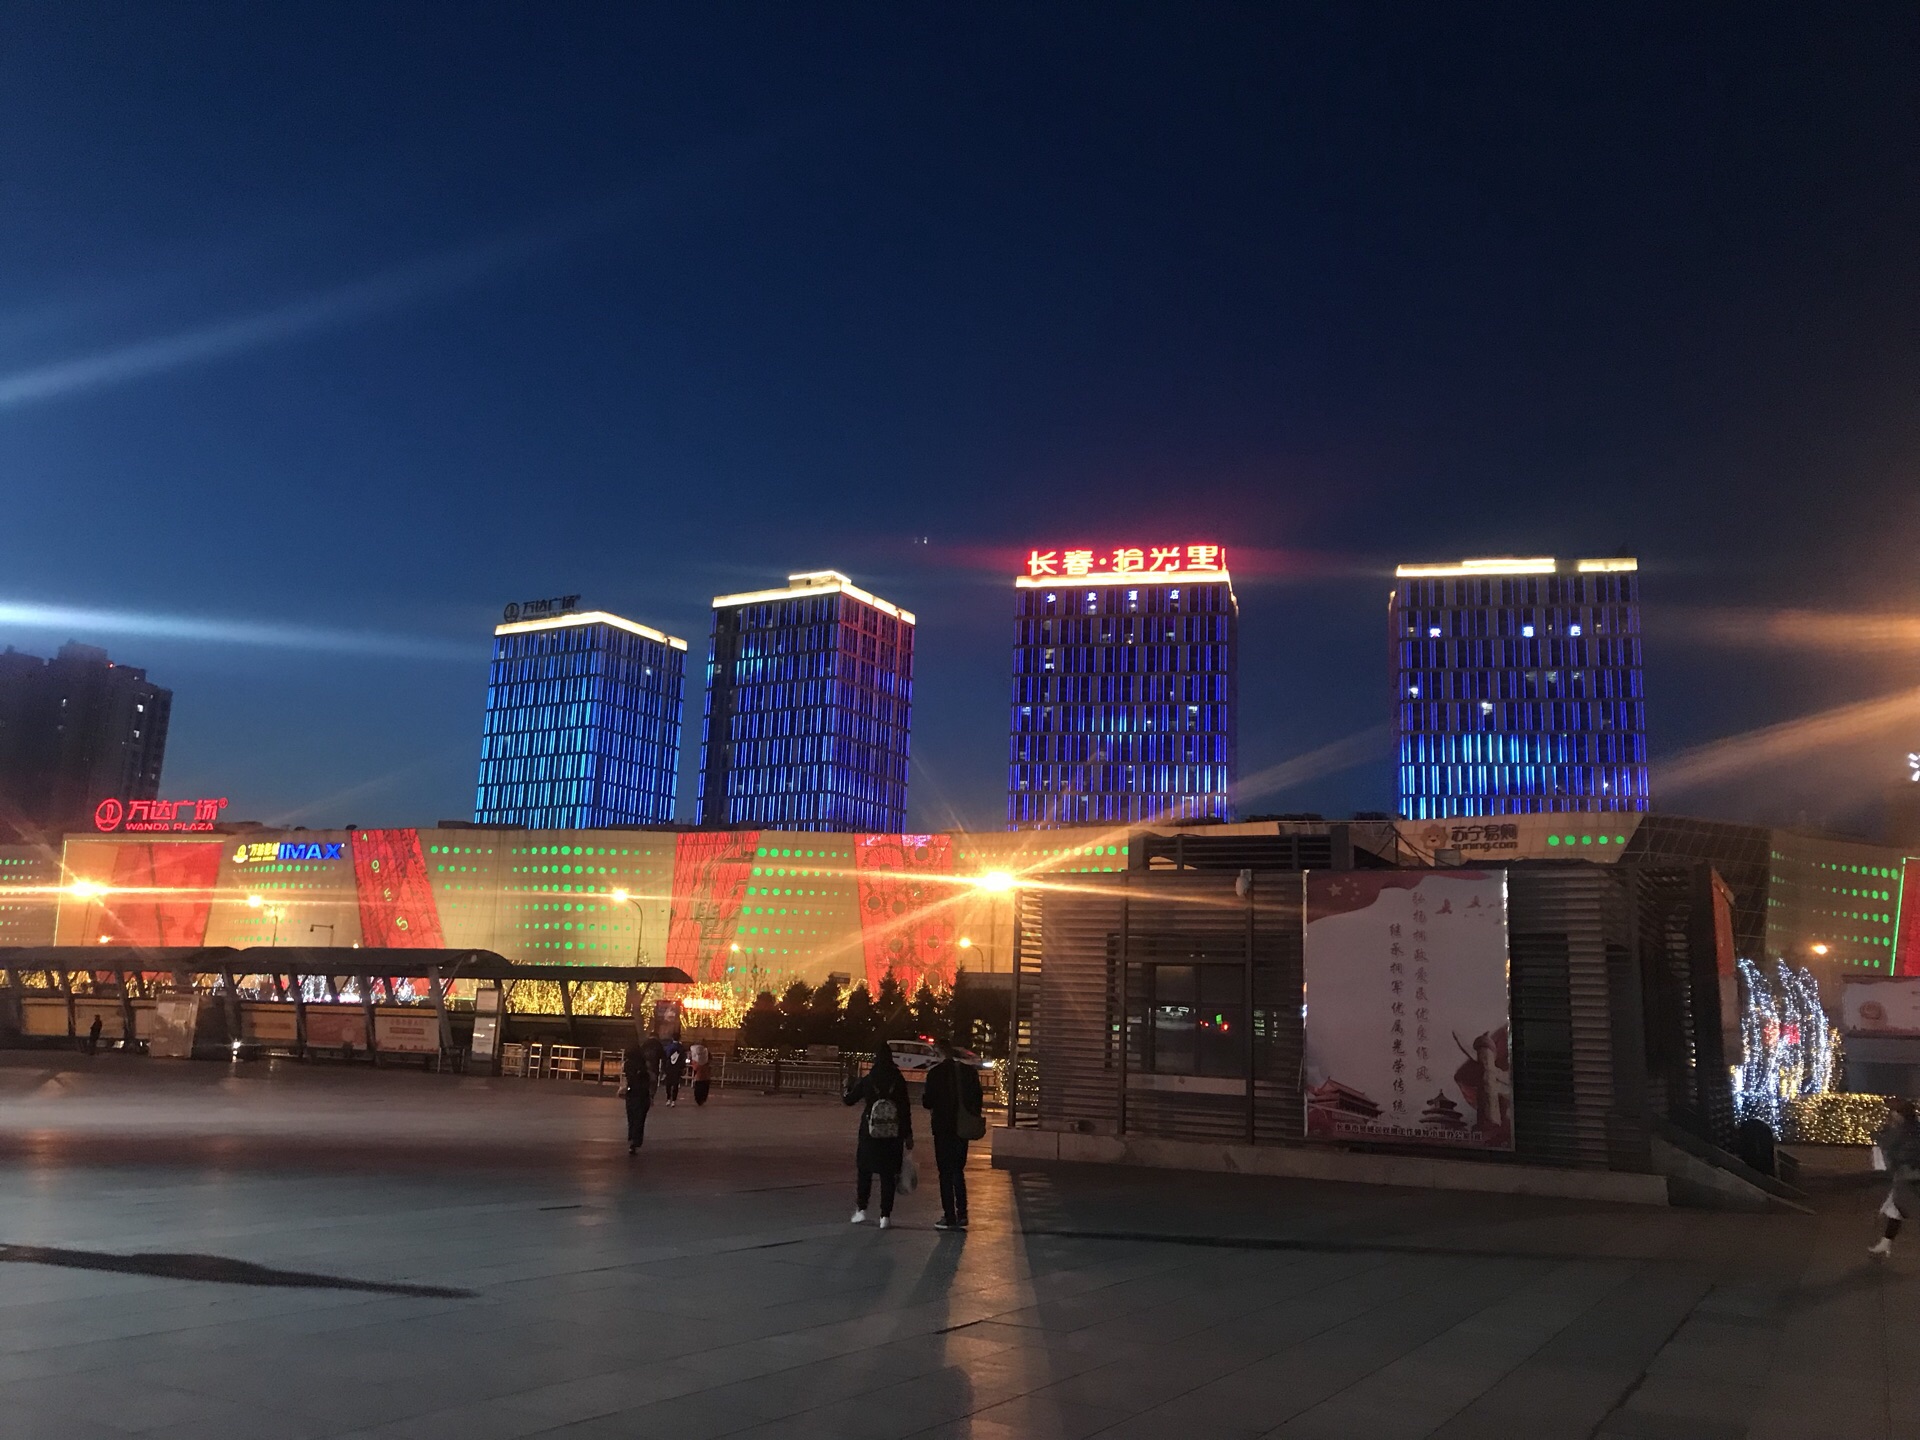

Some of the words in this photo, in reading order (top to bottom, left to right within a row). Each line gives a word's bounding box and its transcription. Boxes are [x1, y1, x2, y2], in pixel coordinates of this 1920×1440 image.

[1027, 545, 1219, 575] 长春·拾光里
[128, 799, 219, 820] 万达广场
[126, 823, 169, 831] WANDA
[173, 822, 215, 831] PLAZA
[1451, 824, 1517, 841] 苏宁易购
[278, 842, 342, 861] IMAX
[1451, 841, 1517, 852] suning.com
[1412, 892, 1431, 1082] 弘扬拥政爱民优良作风
[1389, 924, 1407, 1113] 继承拥军优属光荣传统
